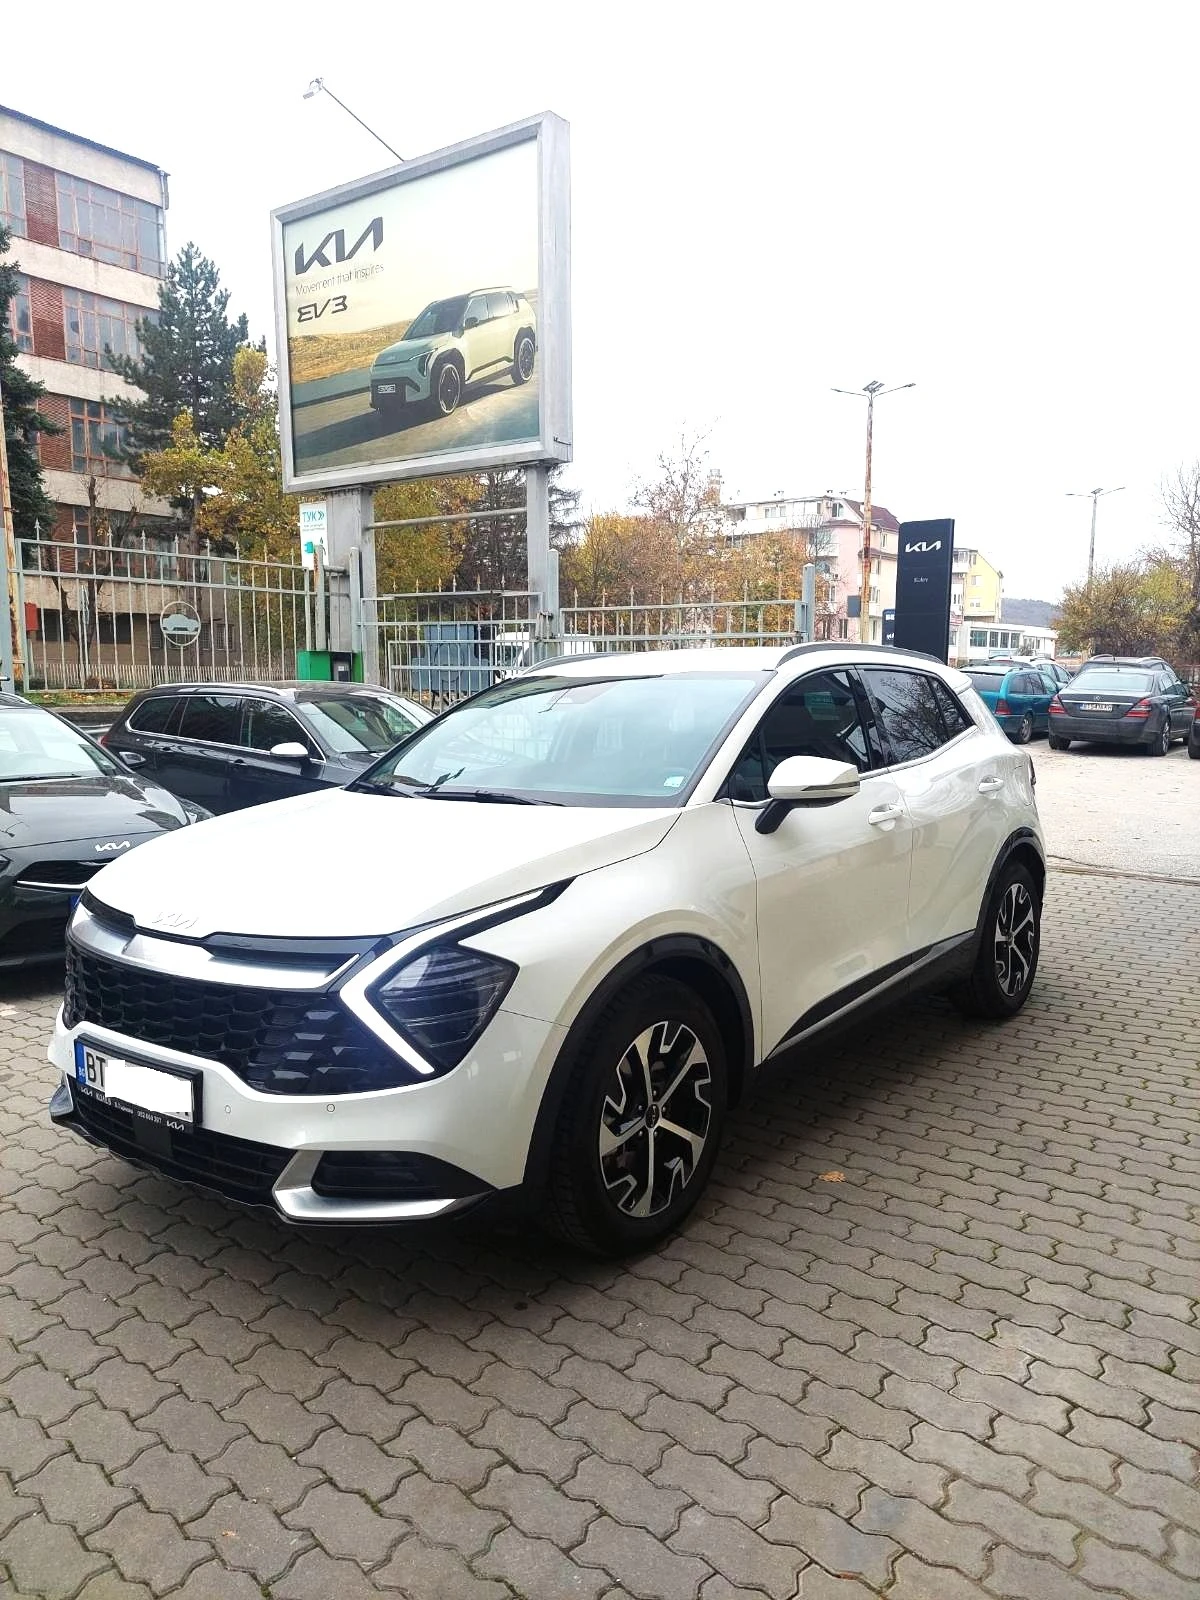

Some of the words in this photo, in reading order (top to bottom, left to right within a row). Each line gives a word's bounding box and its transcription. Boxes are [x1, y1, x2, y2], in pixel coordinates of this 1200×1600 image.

[295, 216, 383, 275] KIA
[296, 277, 335, 296] Movement
[337, 270, 352, 284] that
[354, 263, 384, 279] inspires
[297, 295, 347, 322] EV3
[905, 541, 941, 552] KIA
[95, 841, 130, 852] KIA
[87, 1052, 105, 1086] BT
[166, 1120, 184, 1131] KIA
